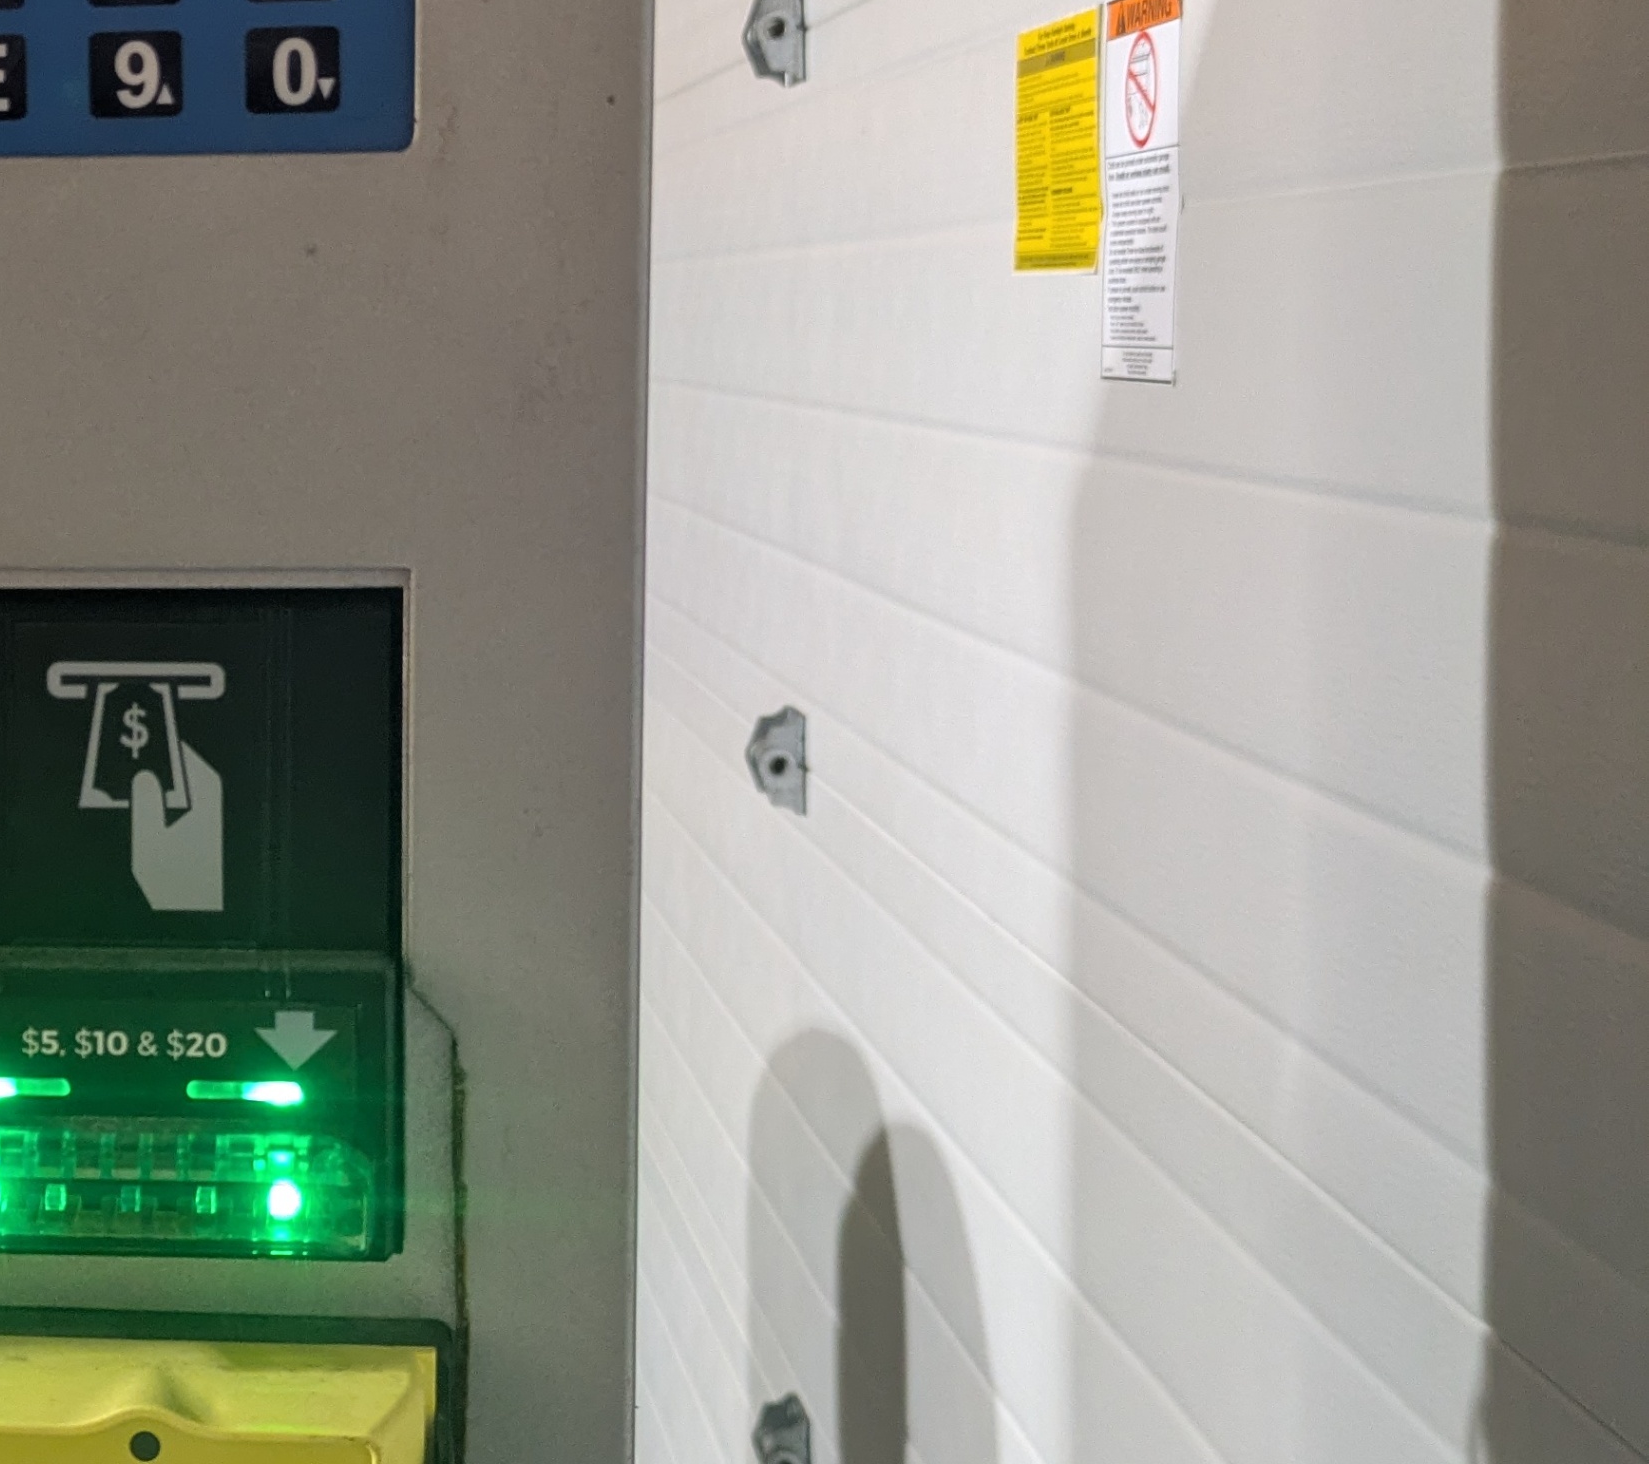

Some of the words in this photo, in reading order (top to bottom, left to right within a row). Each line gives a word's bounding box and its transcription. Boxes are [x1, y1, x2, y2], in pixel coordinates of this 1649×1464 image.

[115, 41, 158, 108] 9
[273, 38, 317, 105] 0
[75, 1027, 129, 1058] $10
[137, 1031, 159, 1057] &
[167, 1028, 228, 1061] $20
